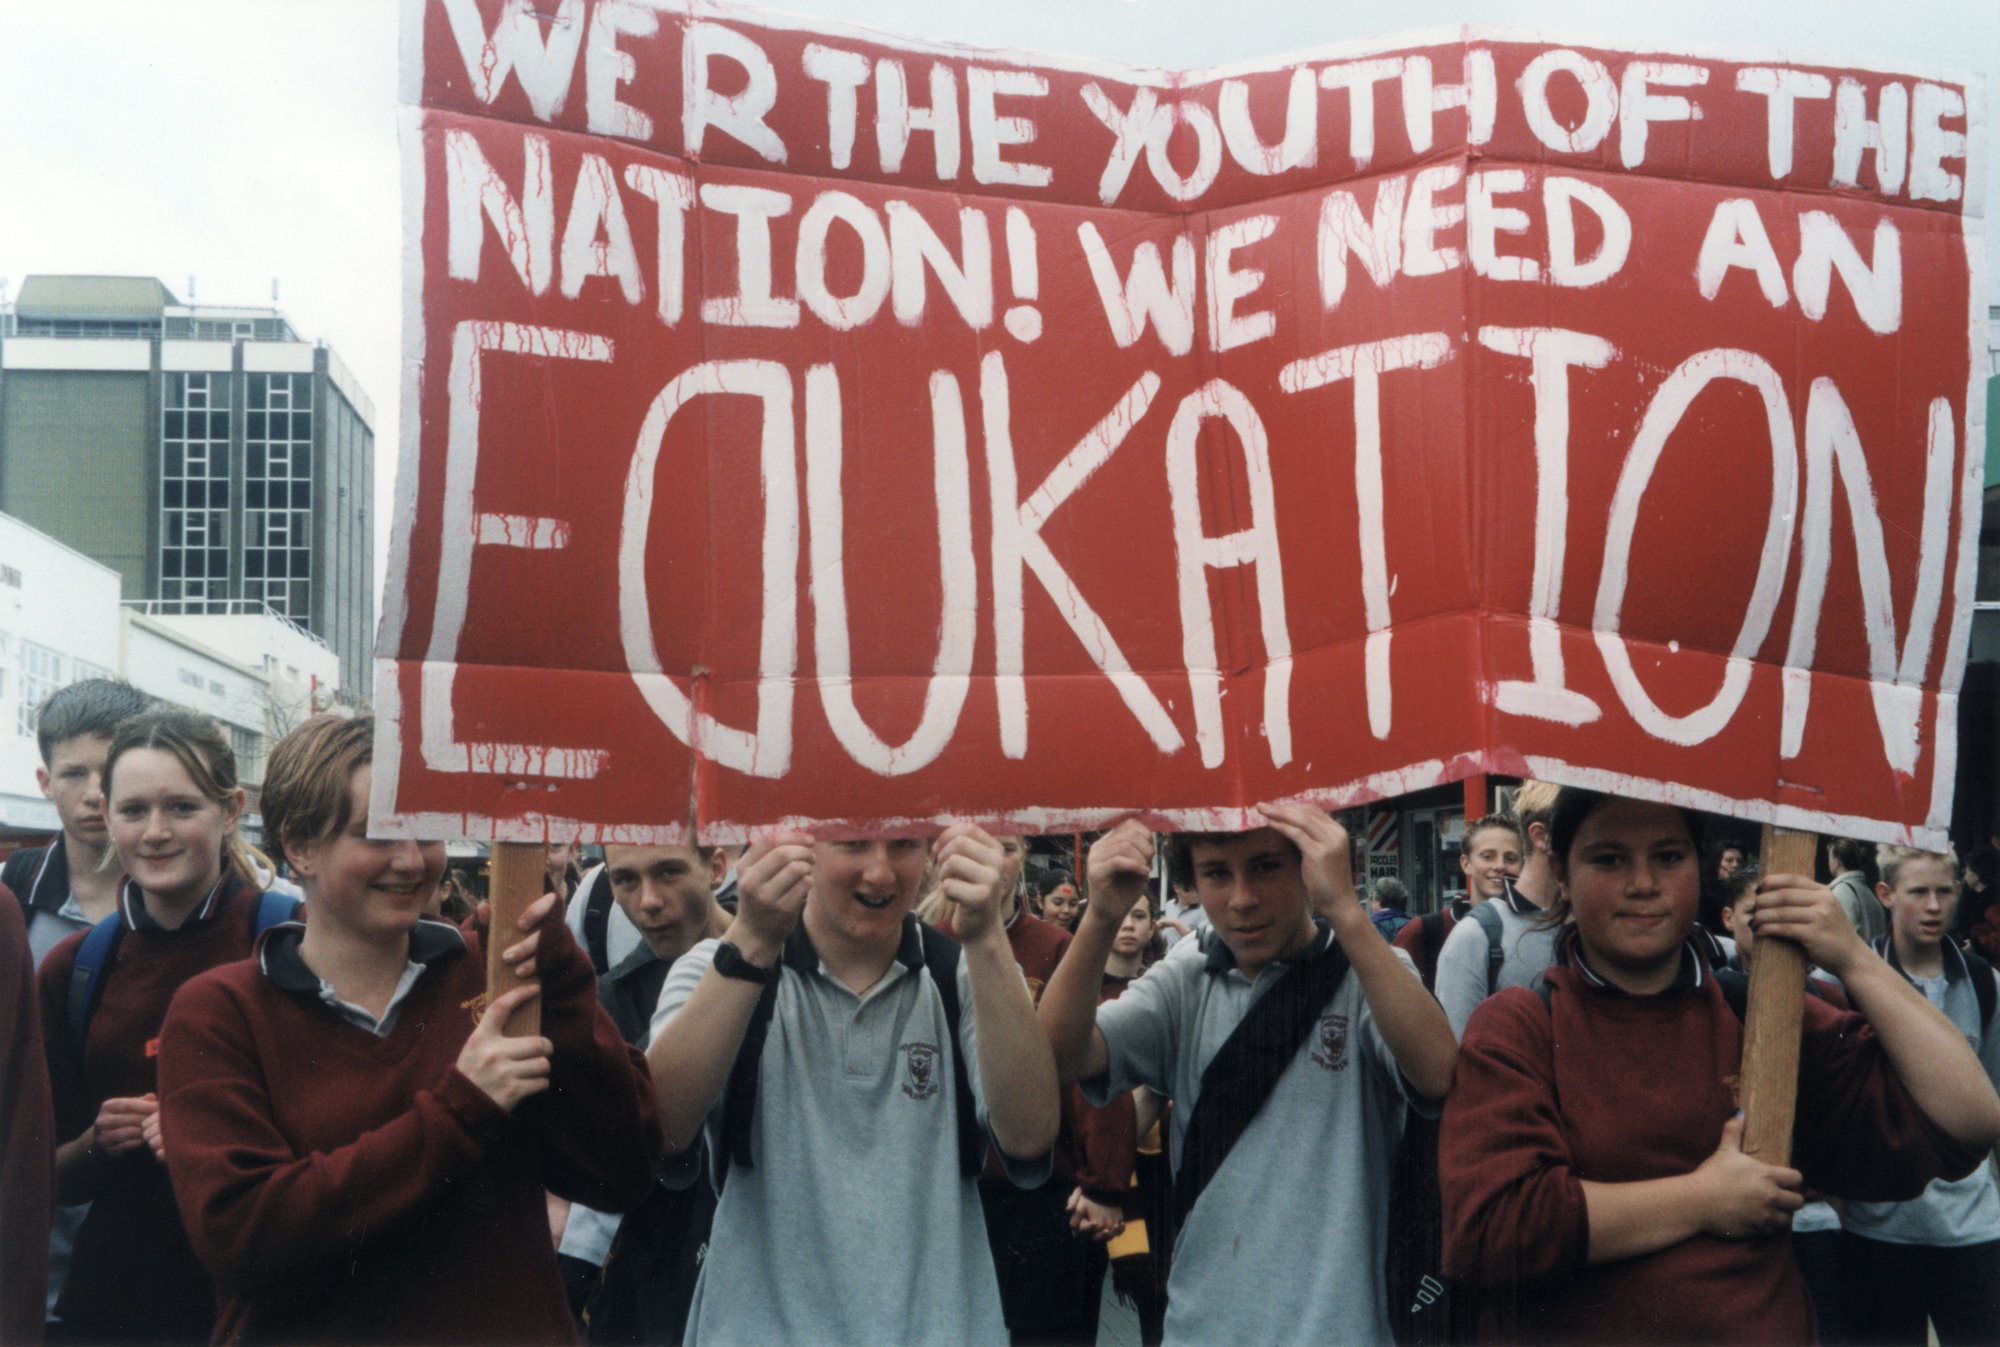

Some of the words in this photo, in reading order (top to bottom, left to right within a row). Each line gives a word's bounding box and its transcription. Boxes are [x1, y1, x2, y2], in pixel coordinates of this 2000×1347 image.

[441, 0, 659, 141] WE
[681, 21, 788, 165] R
[802, 42, 1053, 187] THE
[1079, 48, 1498, 206] YOUTH
[1517, 50, 1710, 169] OF
[1735, 65, 1967, 203] THE
[445, 128, 1044, 344] NATION!
[1077, 215, 1280, 357] WE
[1317, 164, 1632, 311] NEED
[1694, 198, 1902, 335] AN
